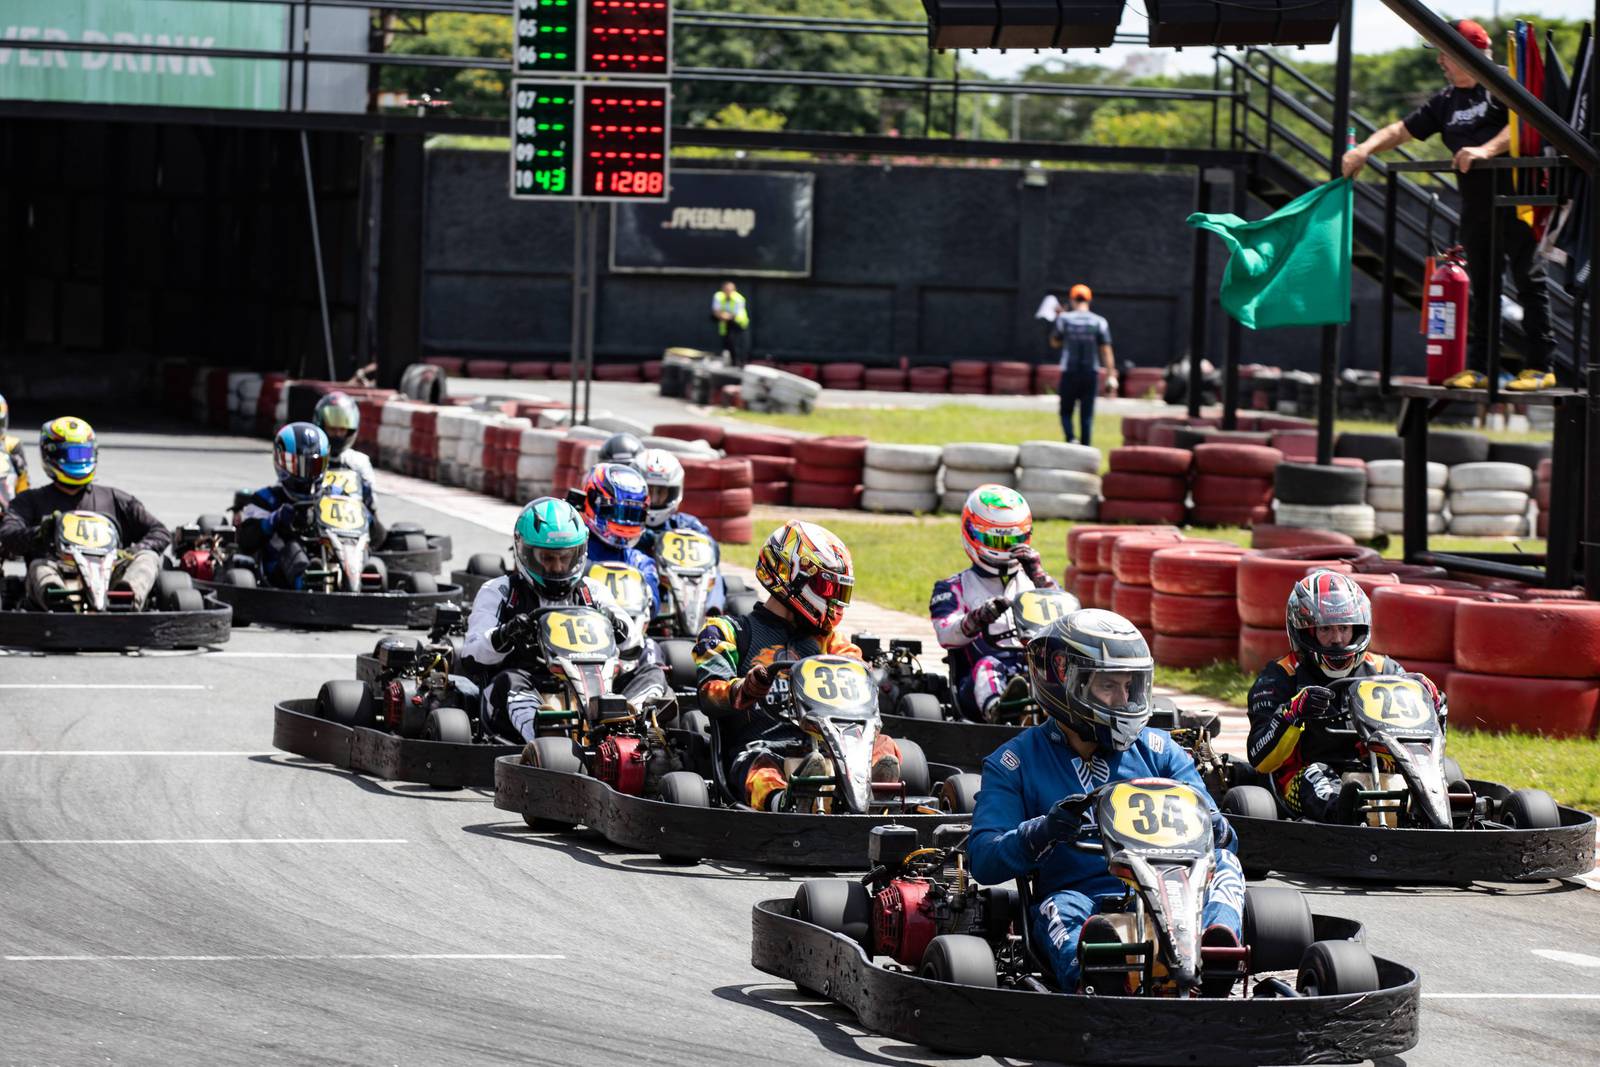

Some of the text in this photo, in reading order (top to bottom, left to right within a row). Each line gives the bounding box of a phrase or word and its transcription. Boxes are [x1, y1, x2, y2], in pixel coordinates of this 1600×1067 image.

[519, 19, 538, 37] 05
[81, 30, 216, 76] DRINK
[519, 45, 538, 64] 06
[517, 90, 537, 109] 07
[516, 116, 536, 136] 08
[516, 143, 535, 162] 09
[515, 170, 533, 189] 10
[535, 169, 566, 191] 43
[672, 538, 702, 562] 35
[1034, 598, 1064, 621] 11
[560, 619, 599, 645] 13
[814, 666, 861, 701] 33
[1372, 686, 1421, 719] 29
[1128, 792, 1189, 837] 34
